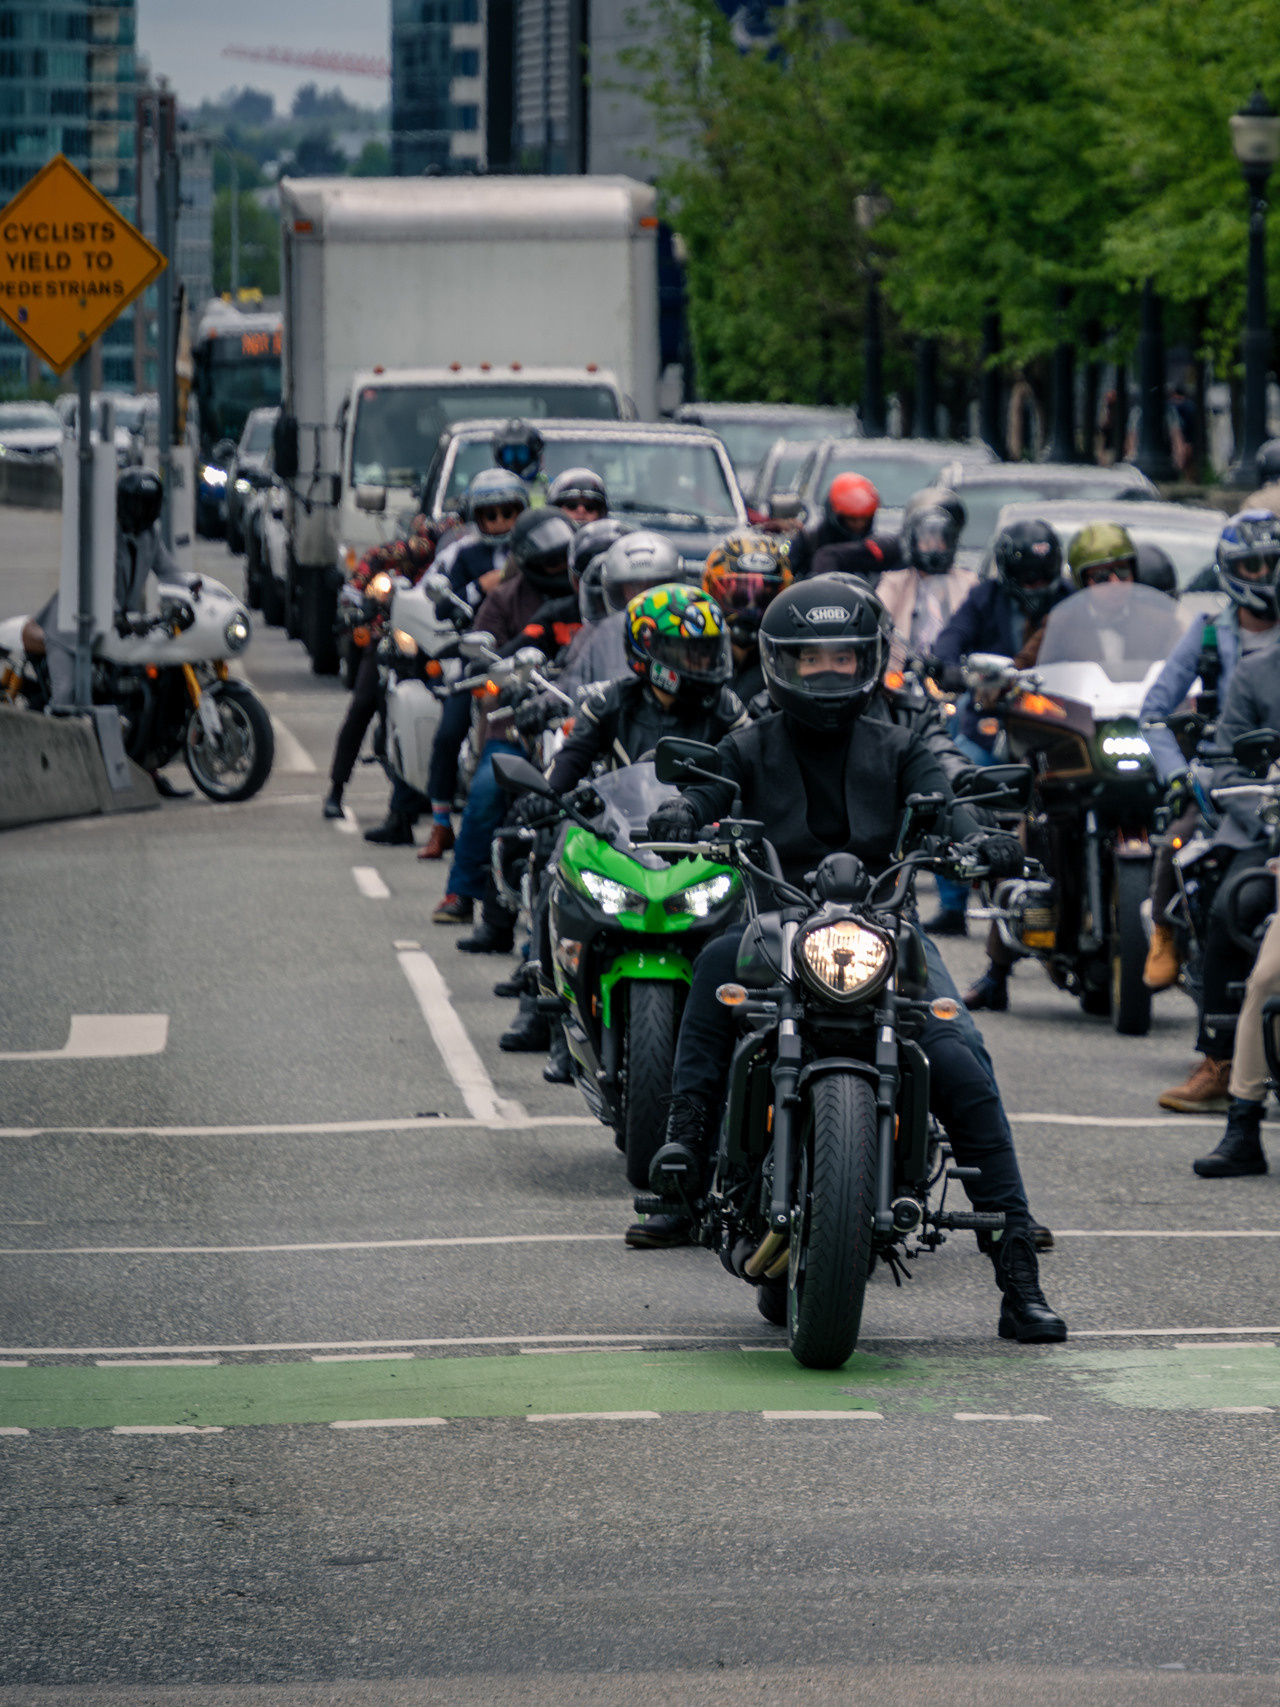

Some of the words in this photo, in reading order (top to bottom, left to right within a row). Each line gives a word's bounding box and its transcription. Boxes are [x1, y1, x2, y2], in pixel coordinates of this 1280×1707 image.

[3, 222, 115, 242] CYCLISTS
[6, 251, 71, 272] YIELD
[83, 251, 113, 271] TO
[811, 608, 845, 620] SHOEI
